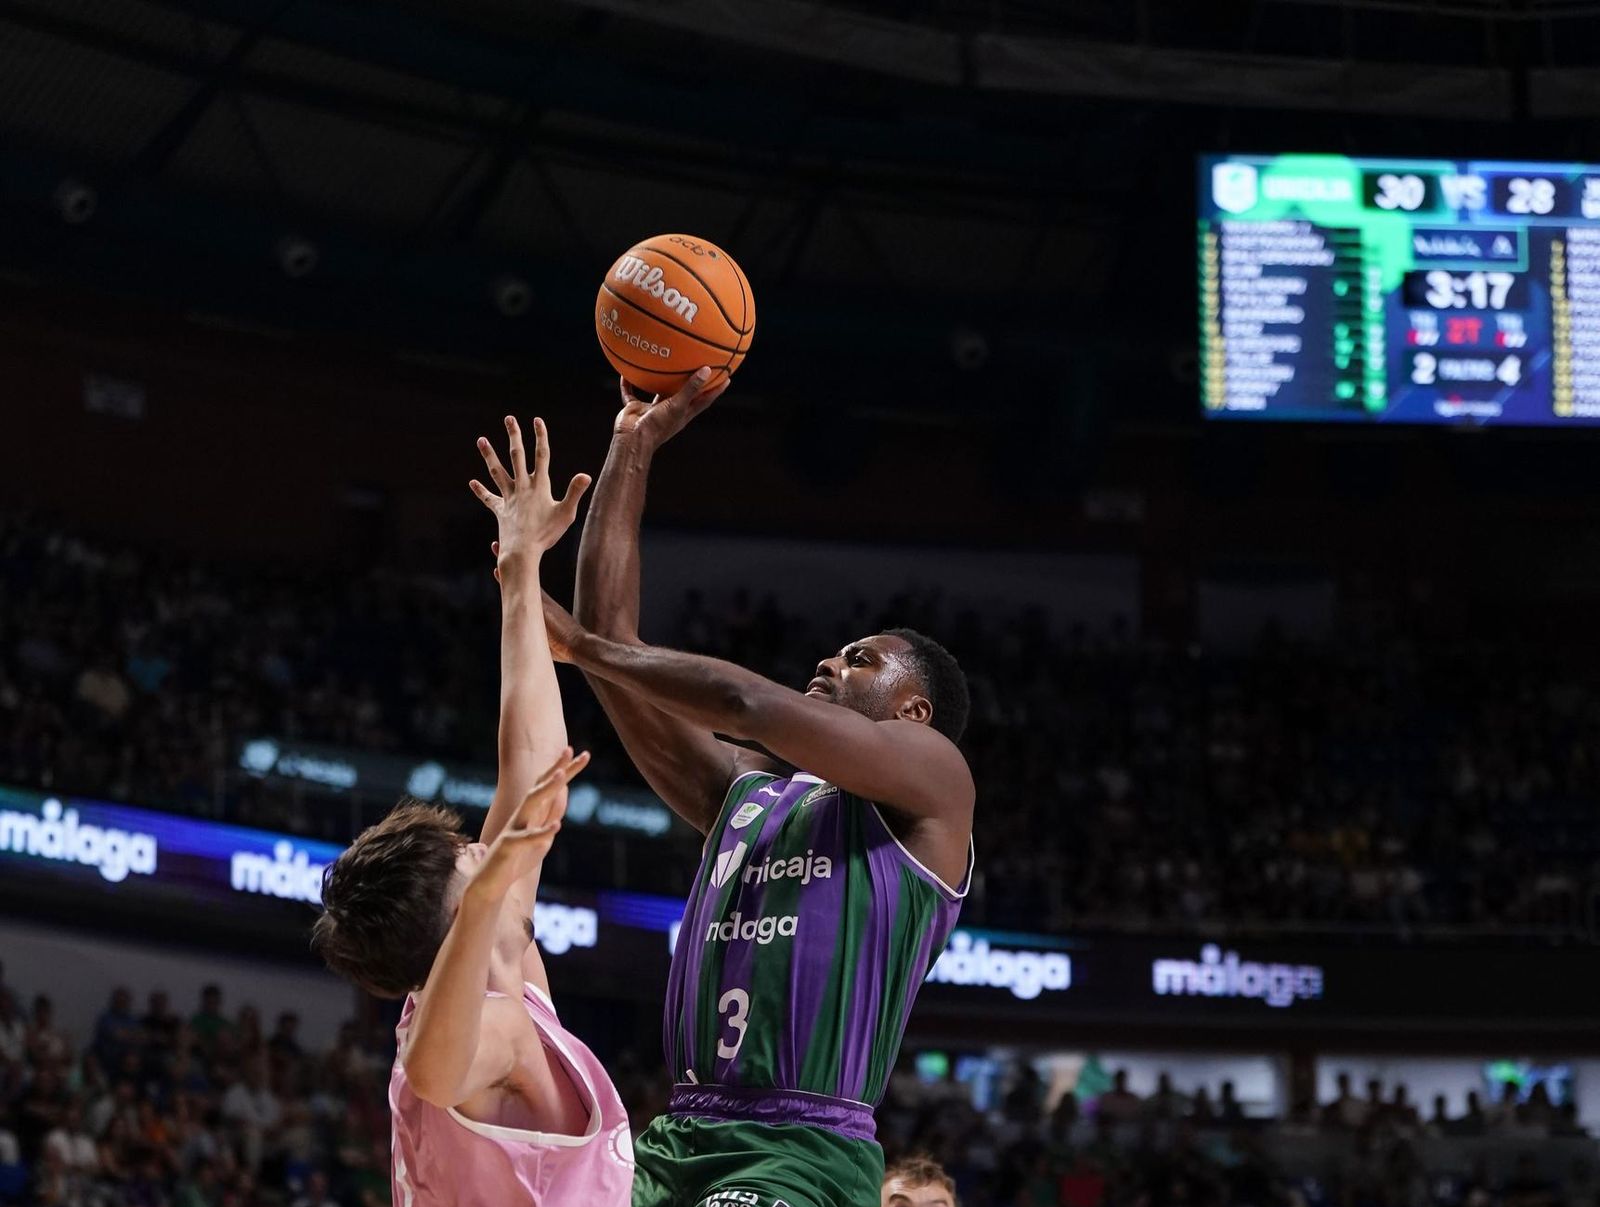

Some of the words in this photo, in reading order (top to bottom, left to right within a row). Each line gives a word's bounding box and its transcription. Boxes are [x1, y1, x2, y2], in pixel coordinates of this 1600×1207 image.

[1375, 174, 1425, 210] 30
[1506, 178, 1555, 214] 28
[614, 256, 699, 324] Wilson
[1425, 270, 1515, 309] 3:17
[1411, 352, 1436, 385] 2
[1496, 354, 1521, 385] 4
[0, 798, 157, 882] málaga
[1152, 943, 1323, 1007] málaga
[717, 988, 749, 1059] 3
